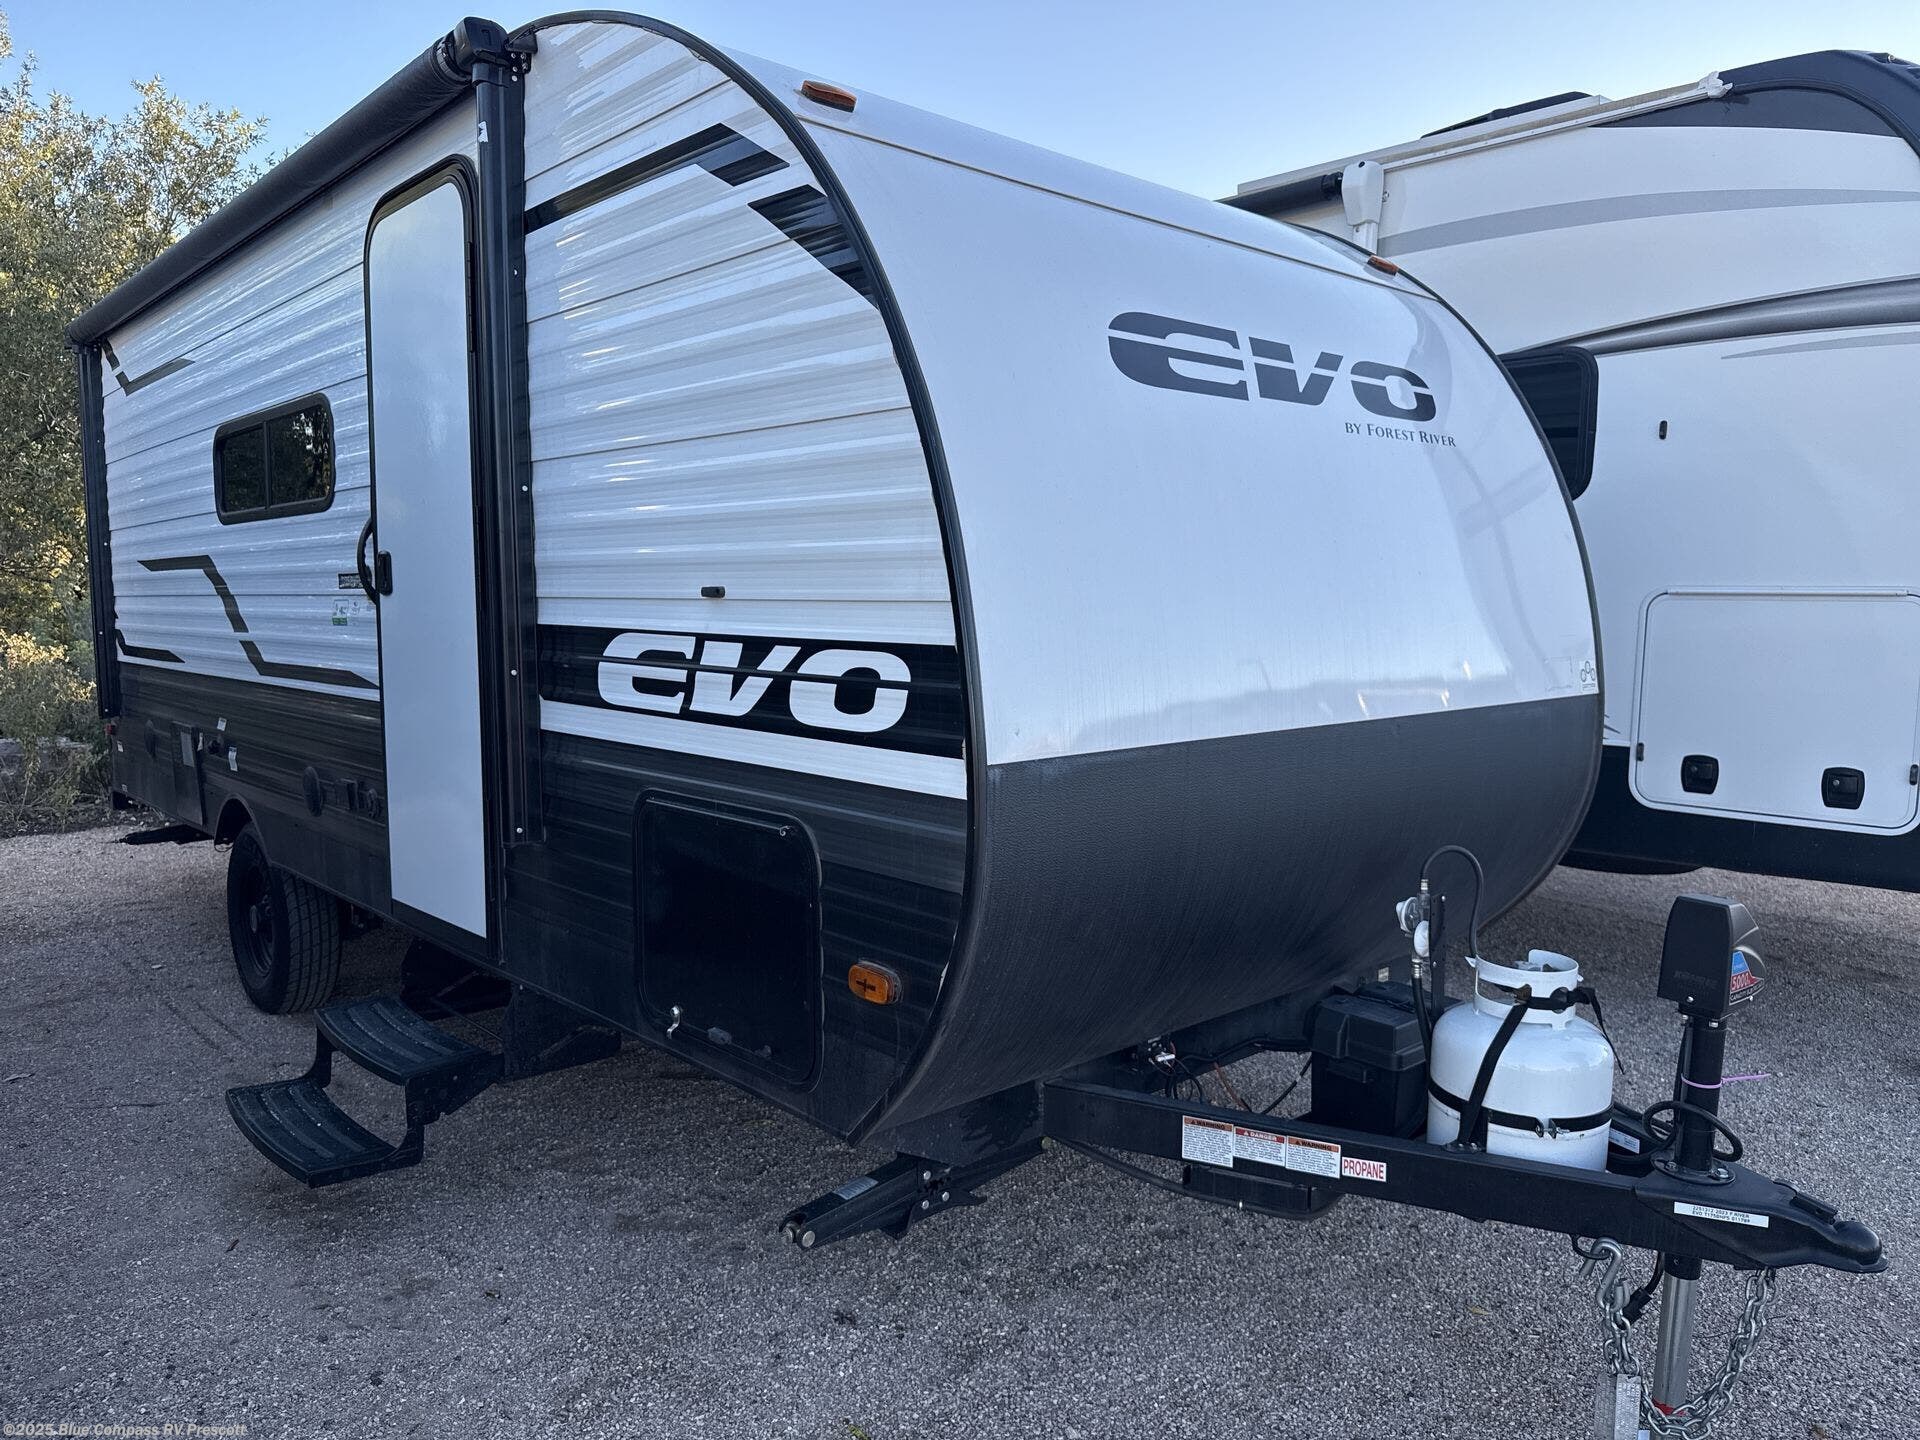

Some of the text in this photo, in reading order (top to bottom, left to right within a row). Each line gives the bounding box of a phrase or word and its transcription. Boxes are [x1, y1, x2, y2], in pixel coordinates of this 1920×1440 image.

[1108, 311, 1437, 422] EVO
[1345, 422, 1457, 447] BY FOREST RIVER
[598, 632, 911, 733] EVO
[1196, 1120, 1225, 1130] WARNING
[1249, 1131, 1278, 1142] DANGER
[1301, 1140, 1332, 1151] WARNING
[1342, 1158, 1385, 1179] PROPANE
